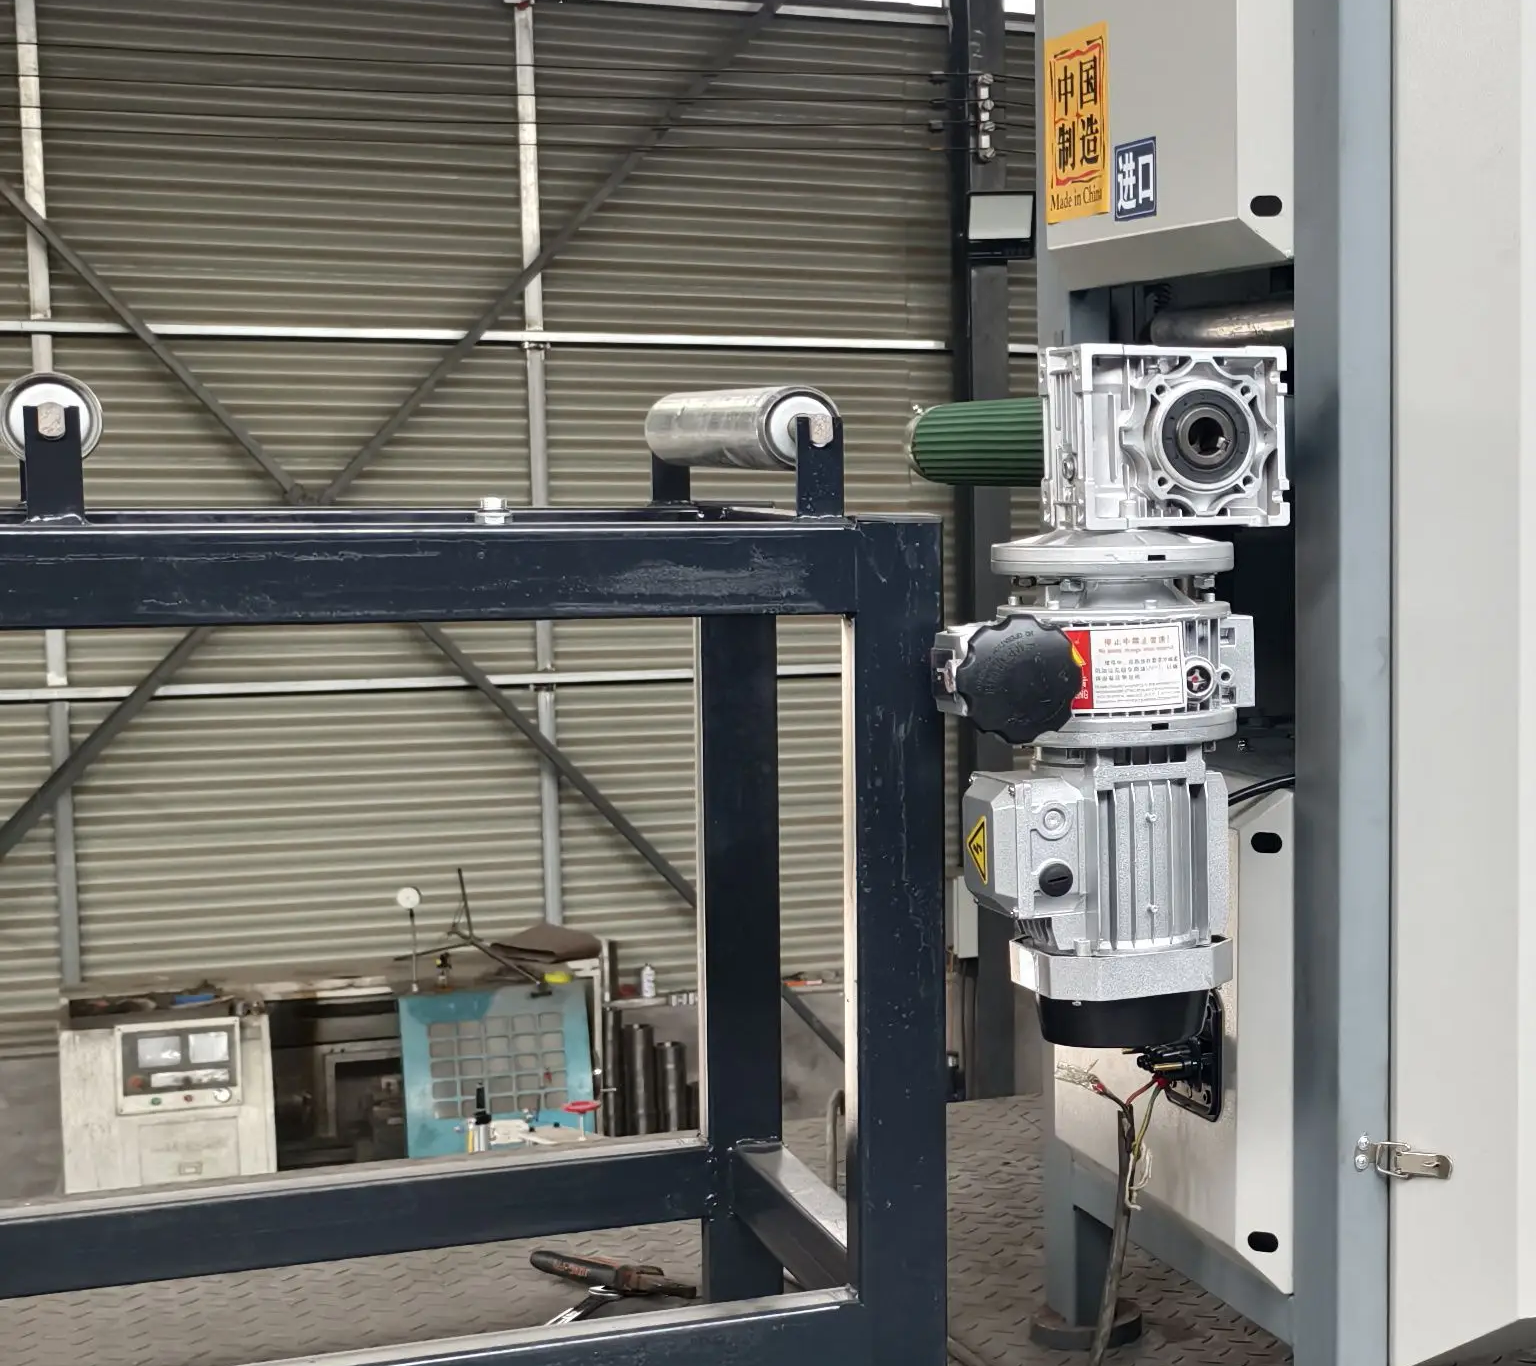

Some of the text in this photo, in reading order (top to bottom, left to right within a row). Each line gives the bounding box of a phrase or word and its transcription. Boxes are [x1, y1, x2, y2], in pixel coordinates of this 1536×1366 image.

[1057, 55, 1098, 116] 中国
[1058, 113, 1099, 173] 制造
[1050, 184, 1103, 212] Made in China
[1117, 151, 1154, 212] 进口
